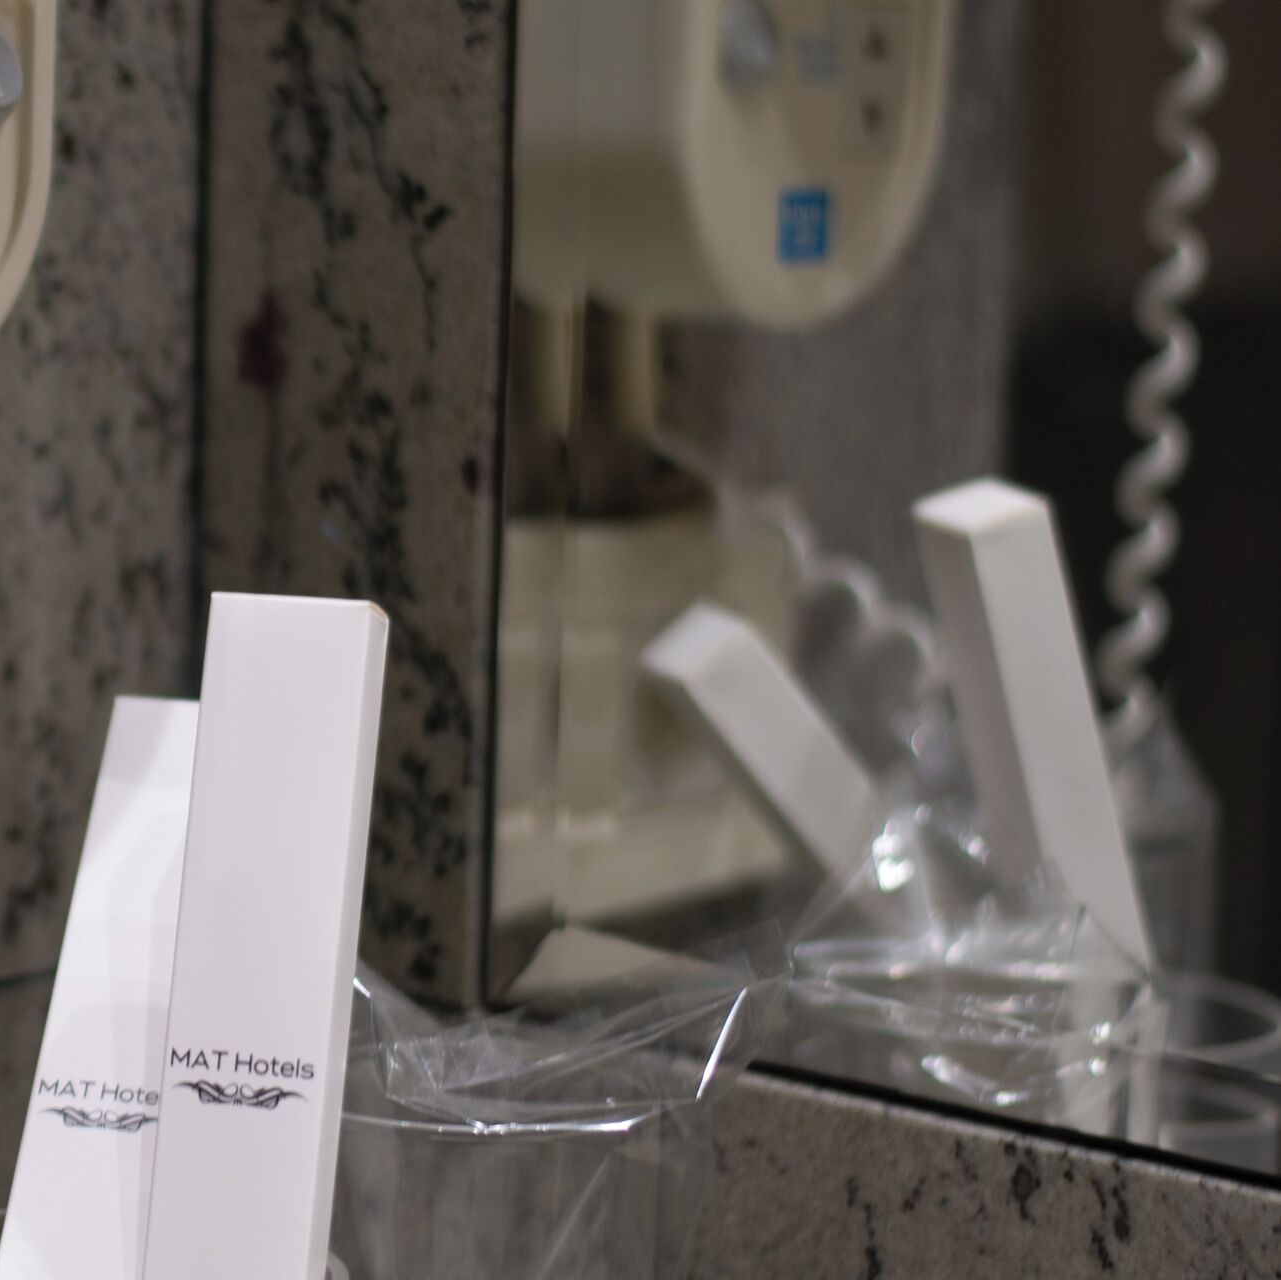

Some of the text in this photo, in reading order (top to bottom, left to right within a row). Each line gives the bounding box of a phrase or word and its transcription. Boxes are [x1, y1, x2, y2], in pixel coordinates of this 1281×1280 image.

[169, 1047, 315, 1081] MAT Hotels
[37, 1078, 159, 1107] MAT Hote
